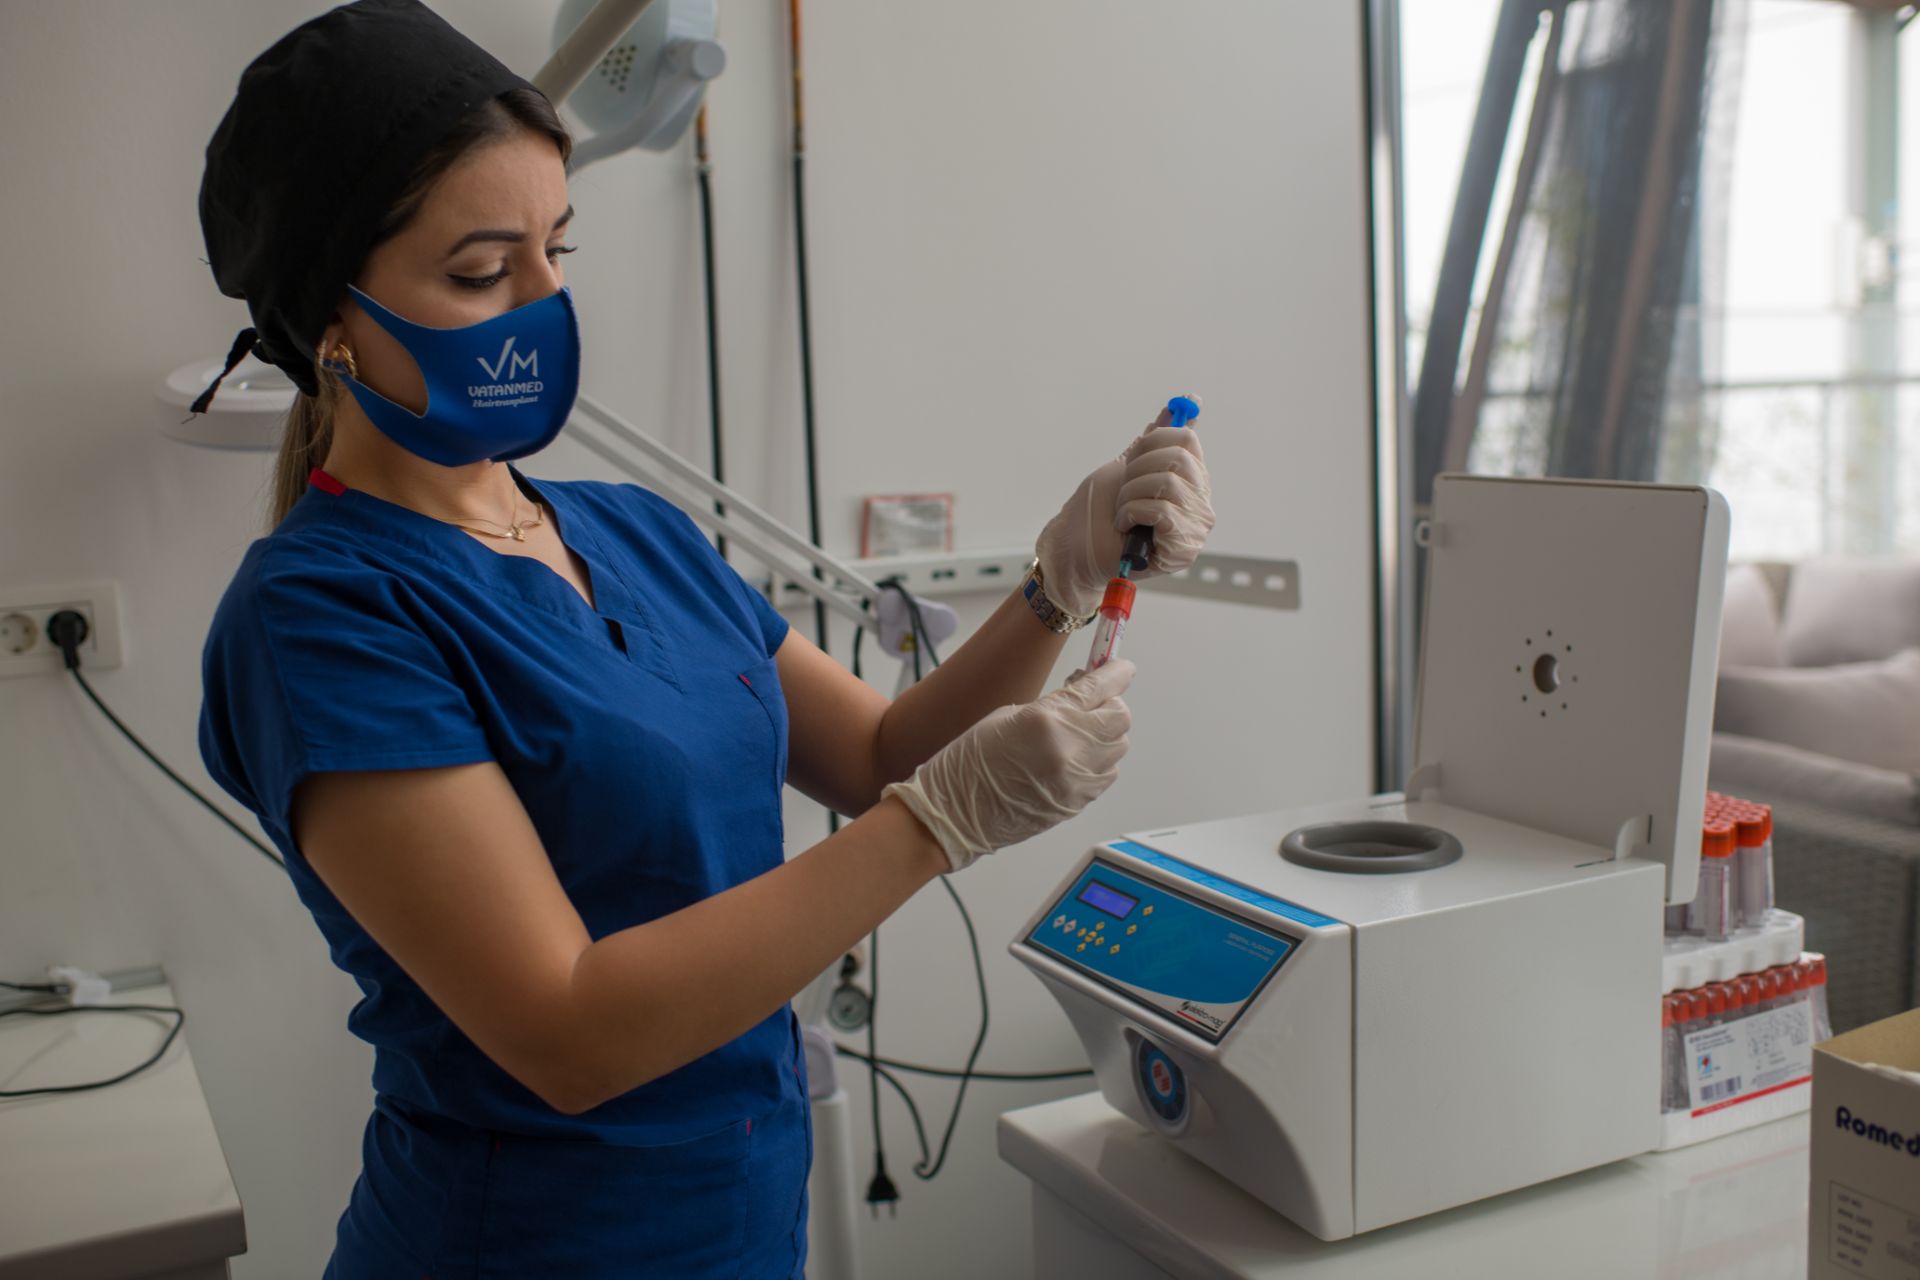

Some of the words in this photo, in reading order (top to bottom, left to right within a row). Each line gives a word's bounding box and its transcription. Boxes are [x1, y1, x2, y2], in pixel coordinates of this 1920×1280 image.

[476, 335, 538, 381] VM
[467, 381, 544, 397] VATANMED
[1835, 1105, 1920, 1158] Romed
